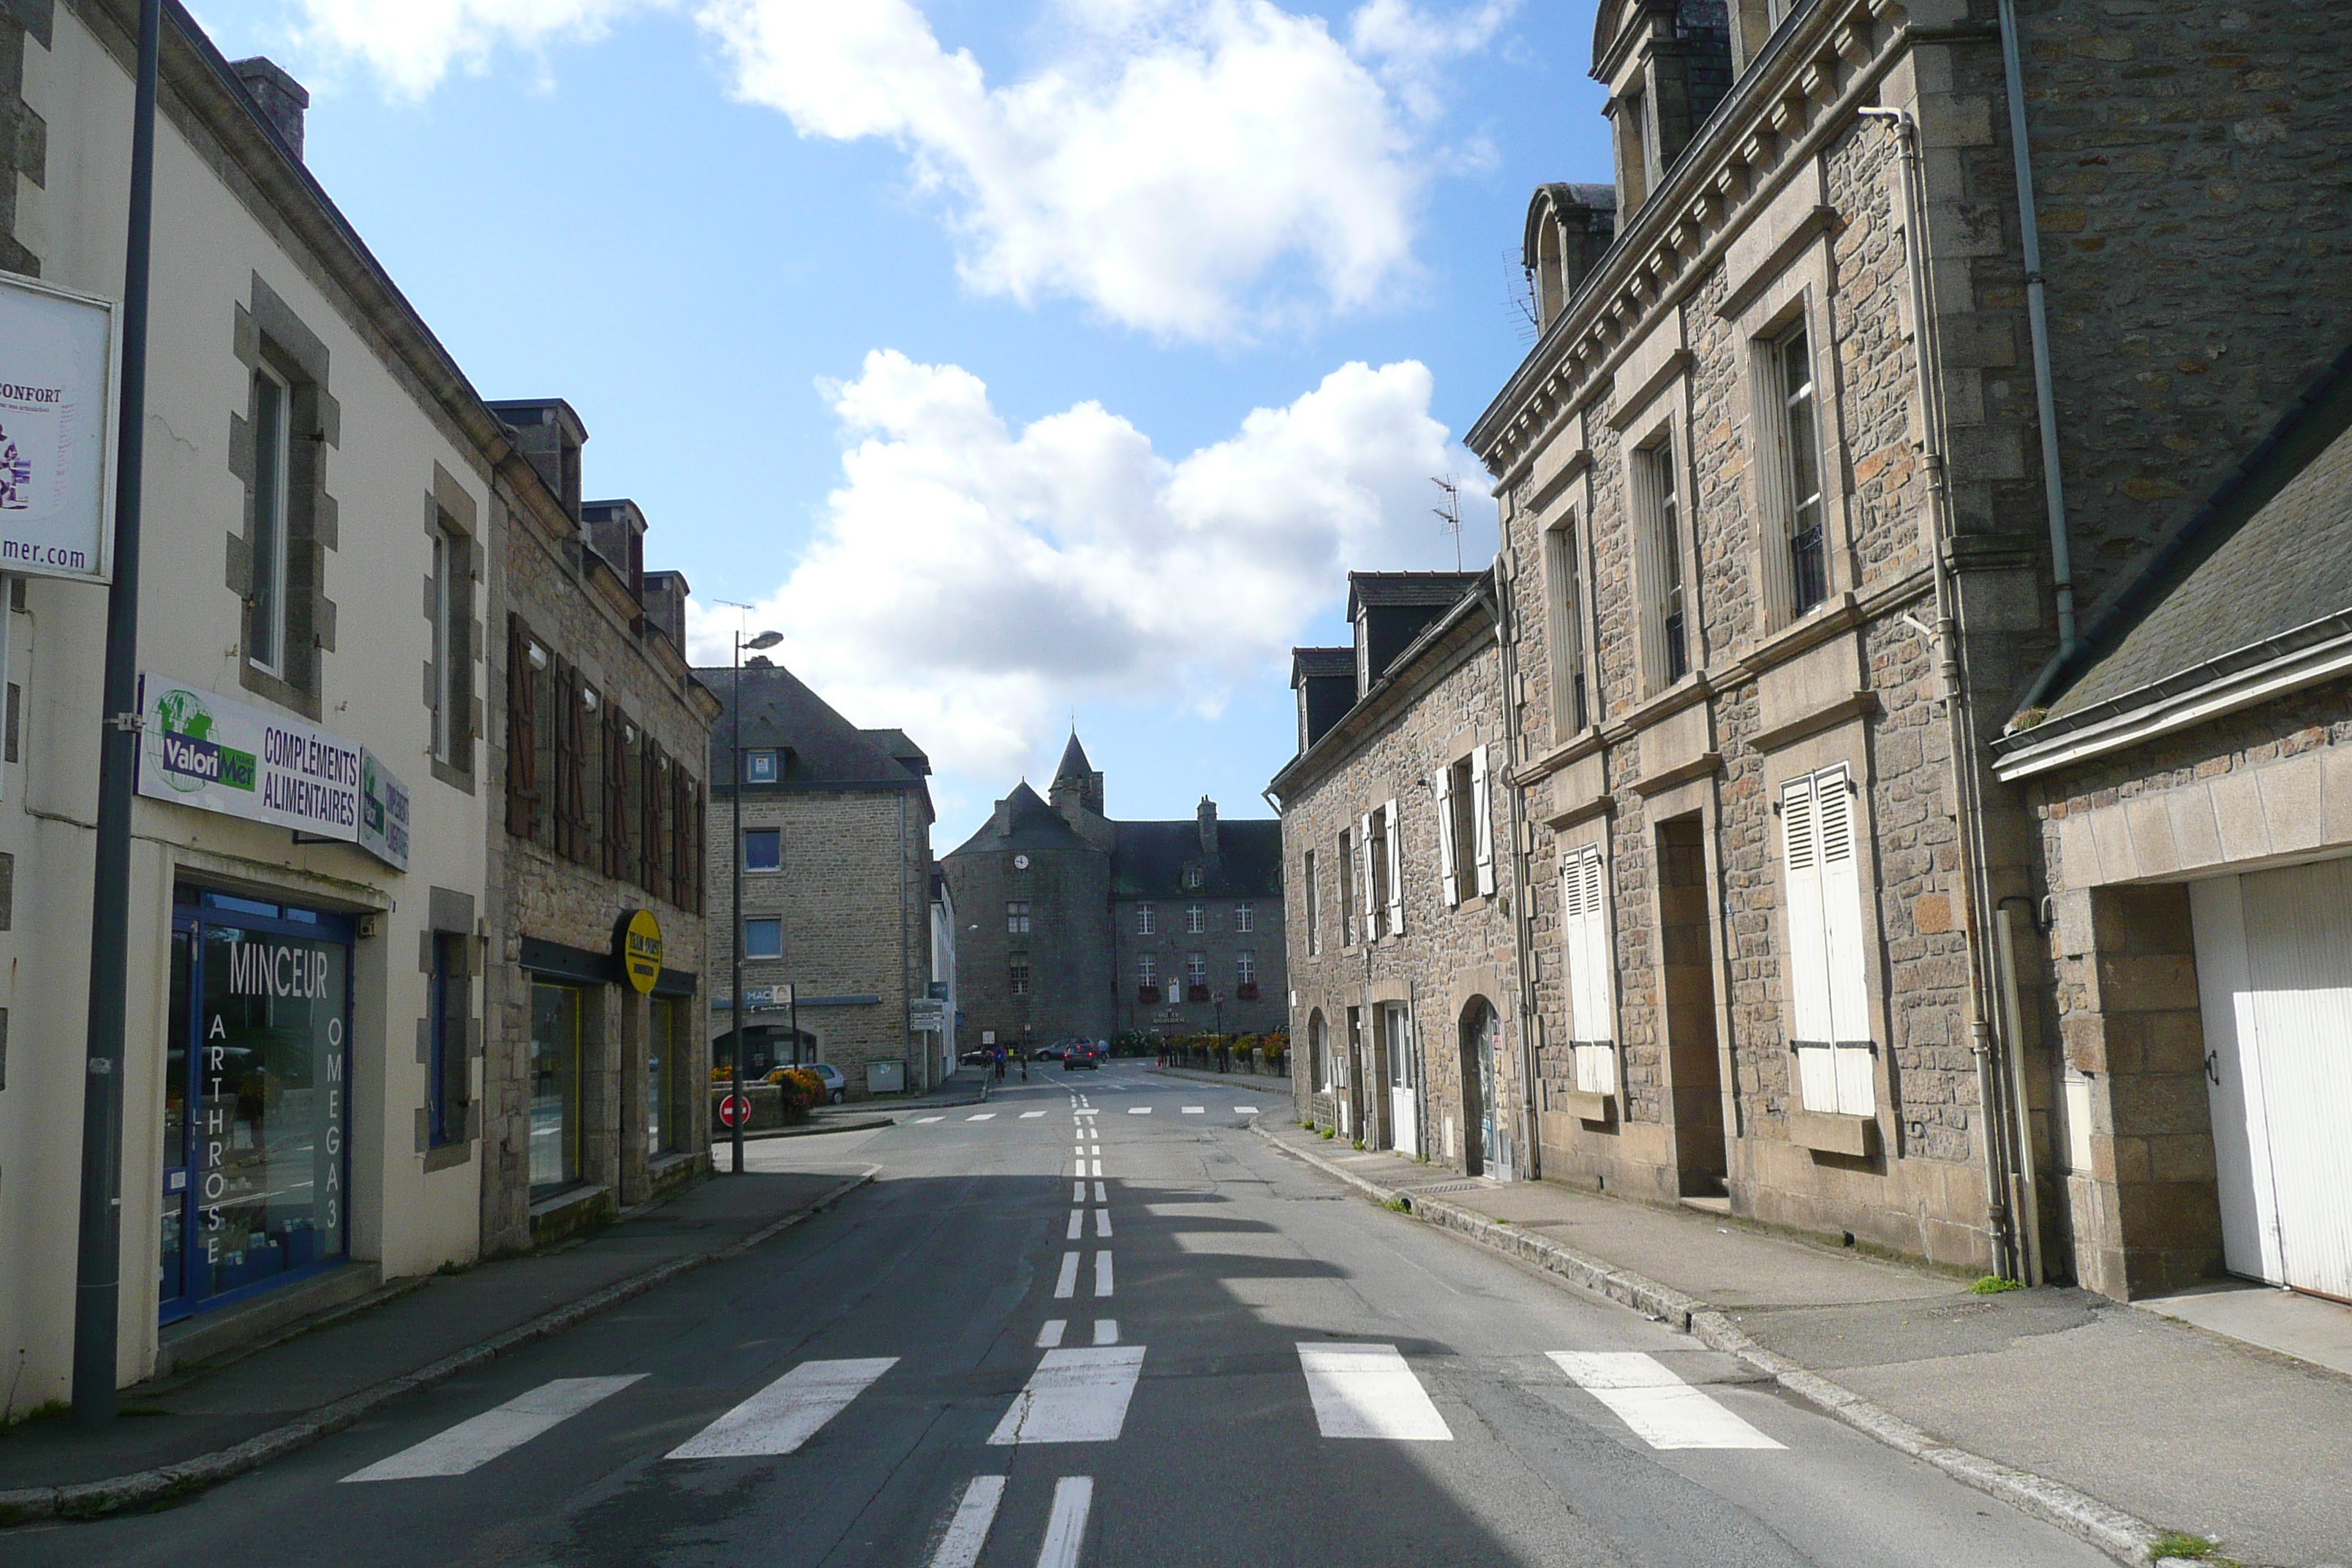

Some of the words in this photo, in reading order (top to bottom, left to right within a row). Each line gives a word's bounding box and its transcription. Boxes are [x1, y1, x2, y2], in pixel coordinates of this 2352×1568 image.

[0, 382, 61, 403] ONFORT
[264, 726, 357, 787] COMPLÉMENTS
[263, 771, 355, 827] ALIMENTAIRES
[230, 941, 328, 999] MINCEUR
